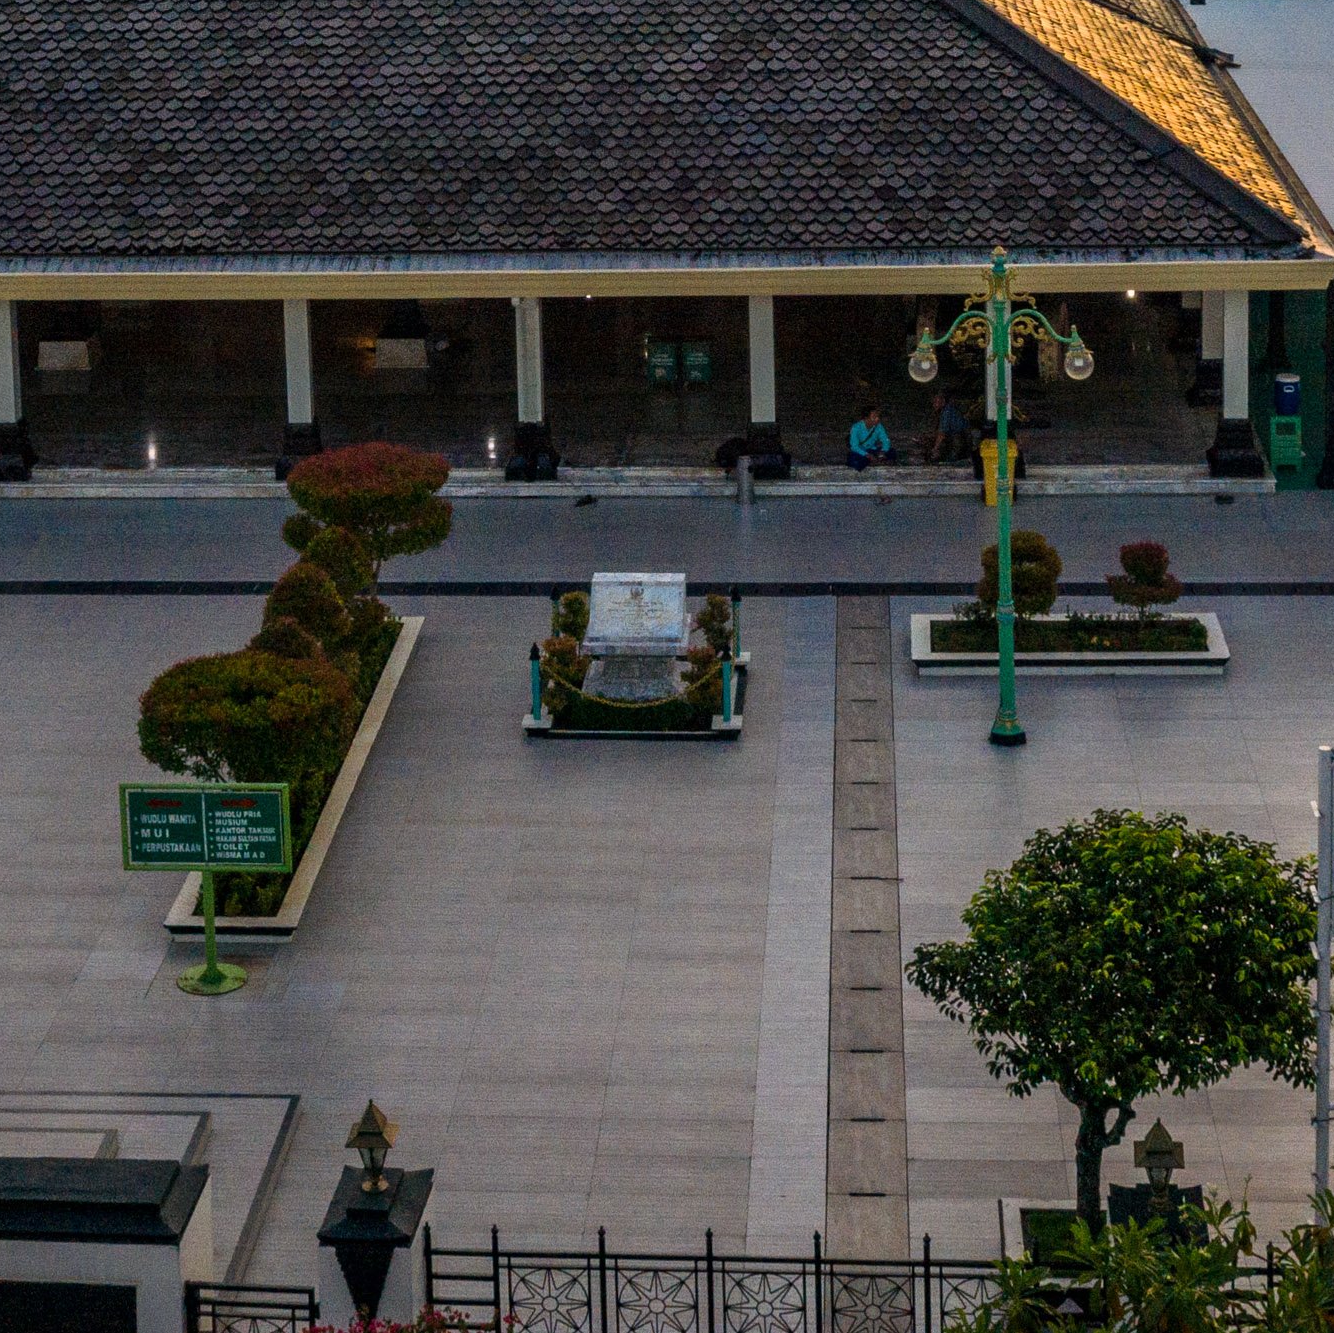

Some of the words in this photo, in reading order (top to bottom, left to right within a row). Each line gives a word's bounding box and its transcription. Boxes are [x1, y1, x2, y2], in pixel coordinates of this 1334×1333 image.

[214, 810, 242, 818] WUDLU
[243, 810, 262, 818] PRIA
[141, 842, 202, 853] PERPUSTAKAAN
[216, 843, 250, 851] TOILET
